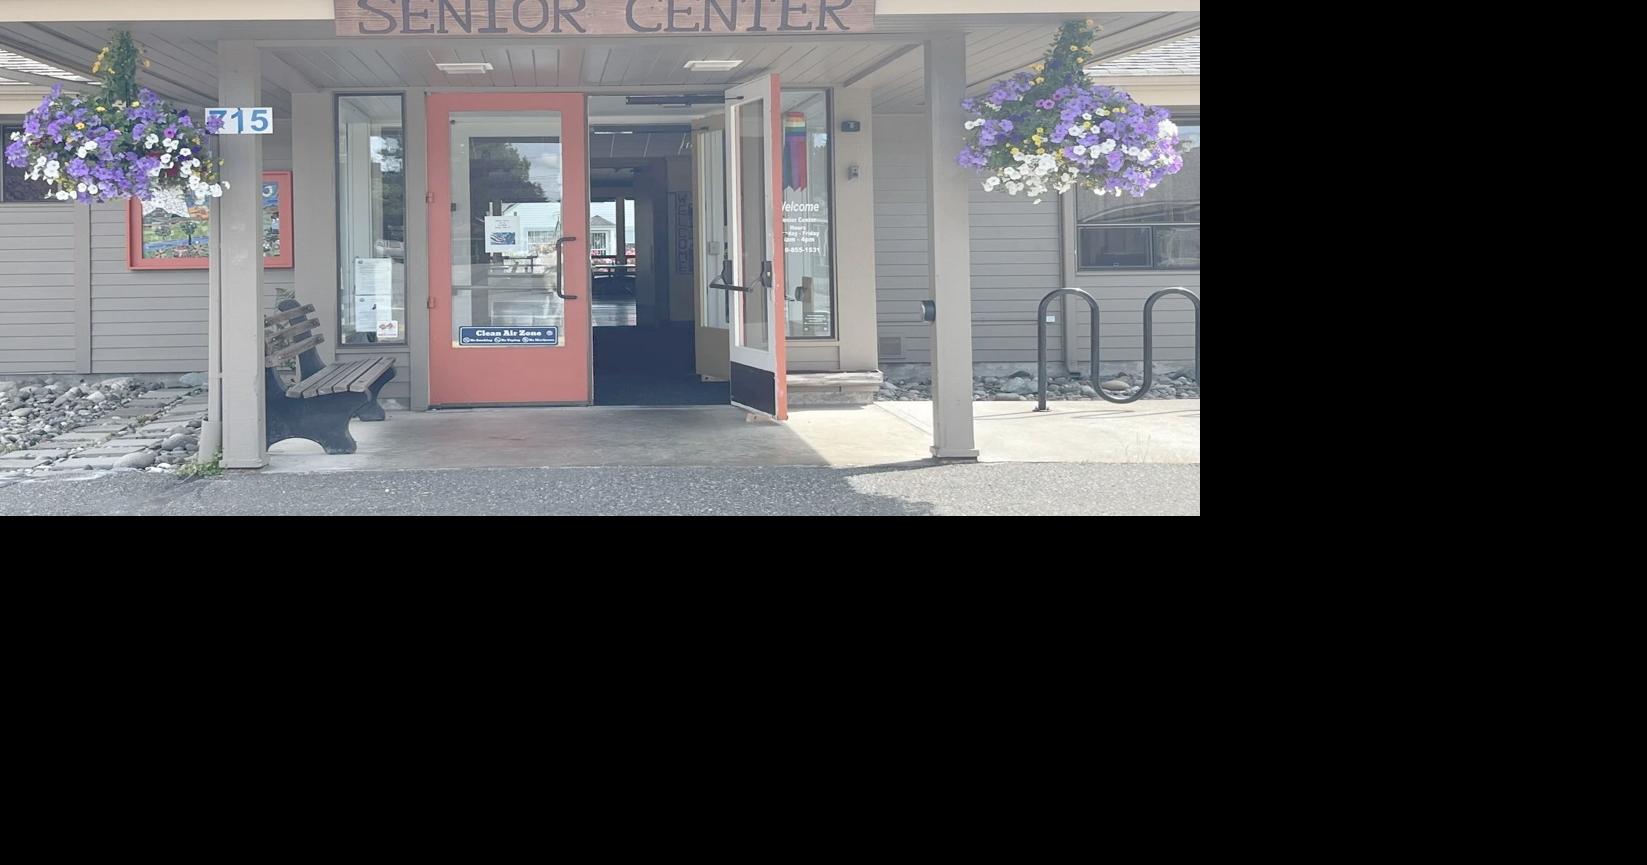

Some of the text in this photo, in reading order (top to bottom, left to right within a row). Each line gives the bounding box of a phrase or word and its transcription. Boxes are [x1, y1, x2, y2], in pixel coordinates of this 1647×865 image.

[358, 0, 850, 34] SENIOR CENTER
[208, 109, 269, 132] 715
[475, 329, 542, 337] Clean Air Zone
